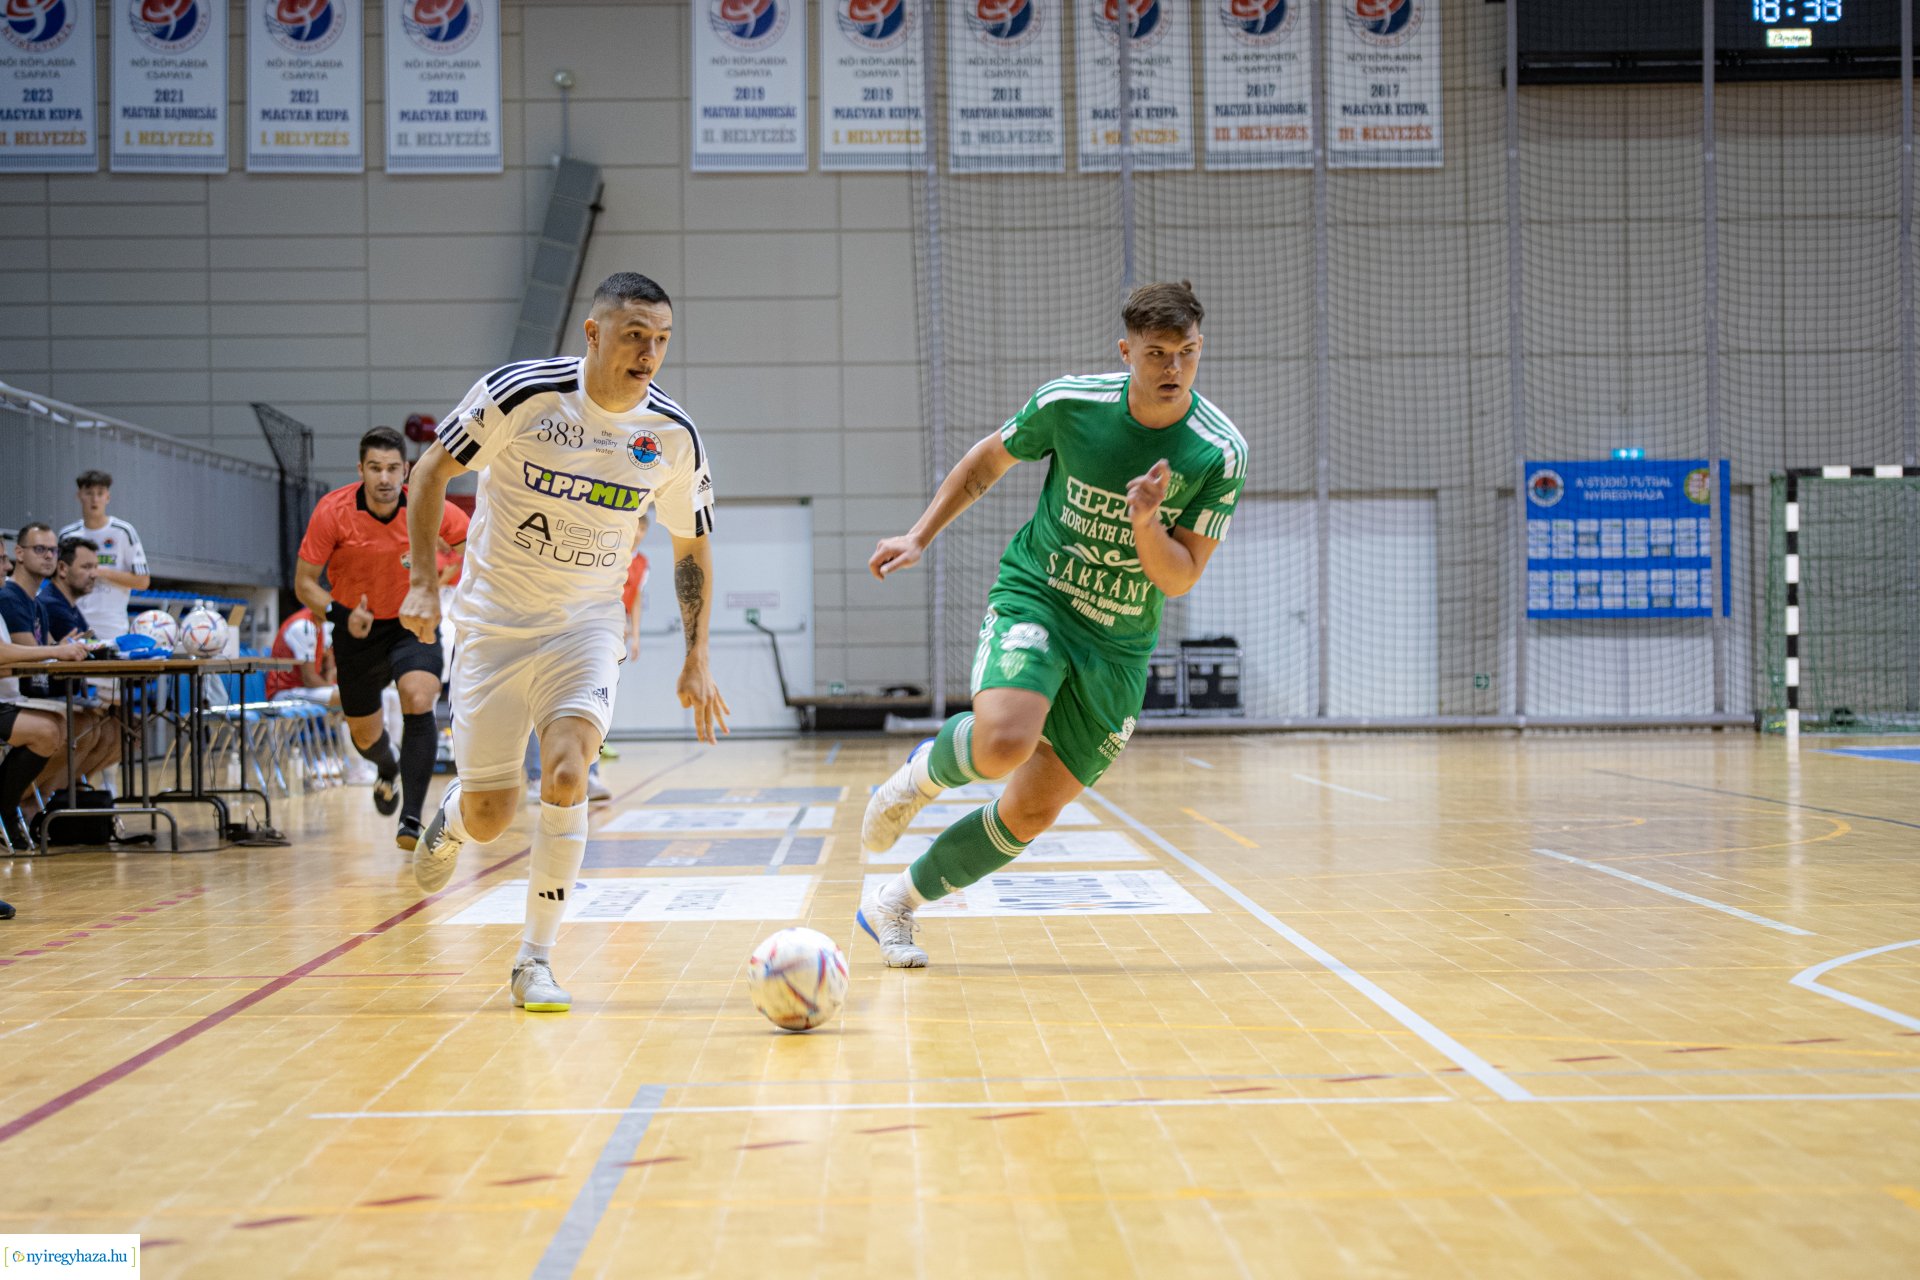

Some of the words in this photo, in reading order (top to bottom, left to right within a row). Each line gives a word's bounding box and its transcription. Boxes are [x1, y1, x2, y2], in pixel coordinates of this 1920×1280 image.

[23, 88, 53, 103] 2023
[154, 88, 183, 103] 2021
[290, 89, 319, 103] 2021
[428, 89, 459, 104] 2020
[734, 86, 766, 101] 2019
[863, 87, 894, 102] 2019
[992, 87, 1022, 102] 2018
[1247, 83, 1276, 98] 2017
[1371, 83, 1400, 98] 2017
[49, 108, 83, 121] KUPA
[316, 109, 349, 121] KUPA
[454, 109, 488, 121] KUPA
[888, 107, 923, 119] KUPA
[1146, 107, 1178, 119] KUPA
[1396, 102, 1429, 115] KUPA
[537, 418, 585, 450] 383
[601, 429, 613, 438] the
[595, 447, 614, 456] water
[1060, 504, 1117, 542] HORVÁTH
[513, 531, 617, 568] STUDIO
[1047, 576, 1090, 601] Wellness
